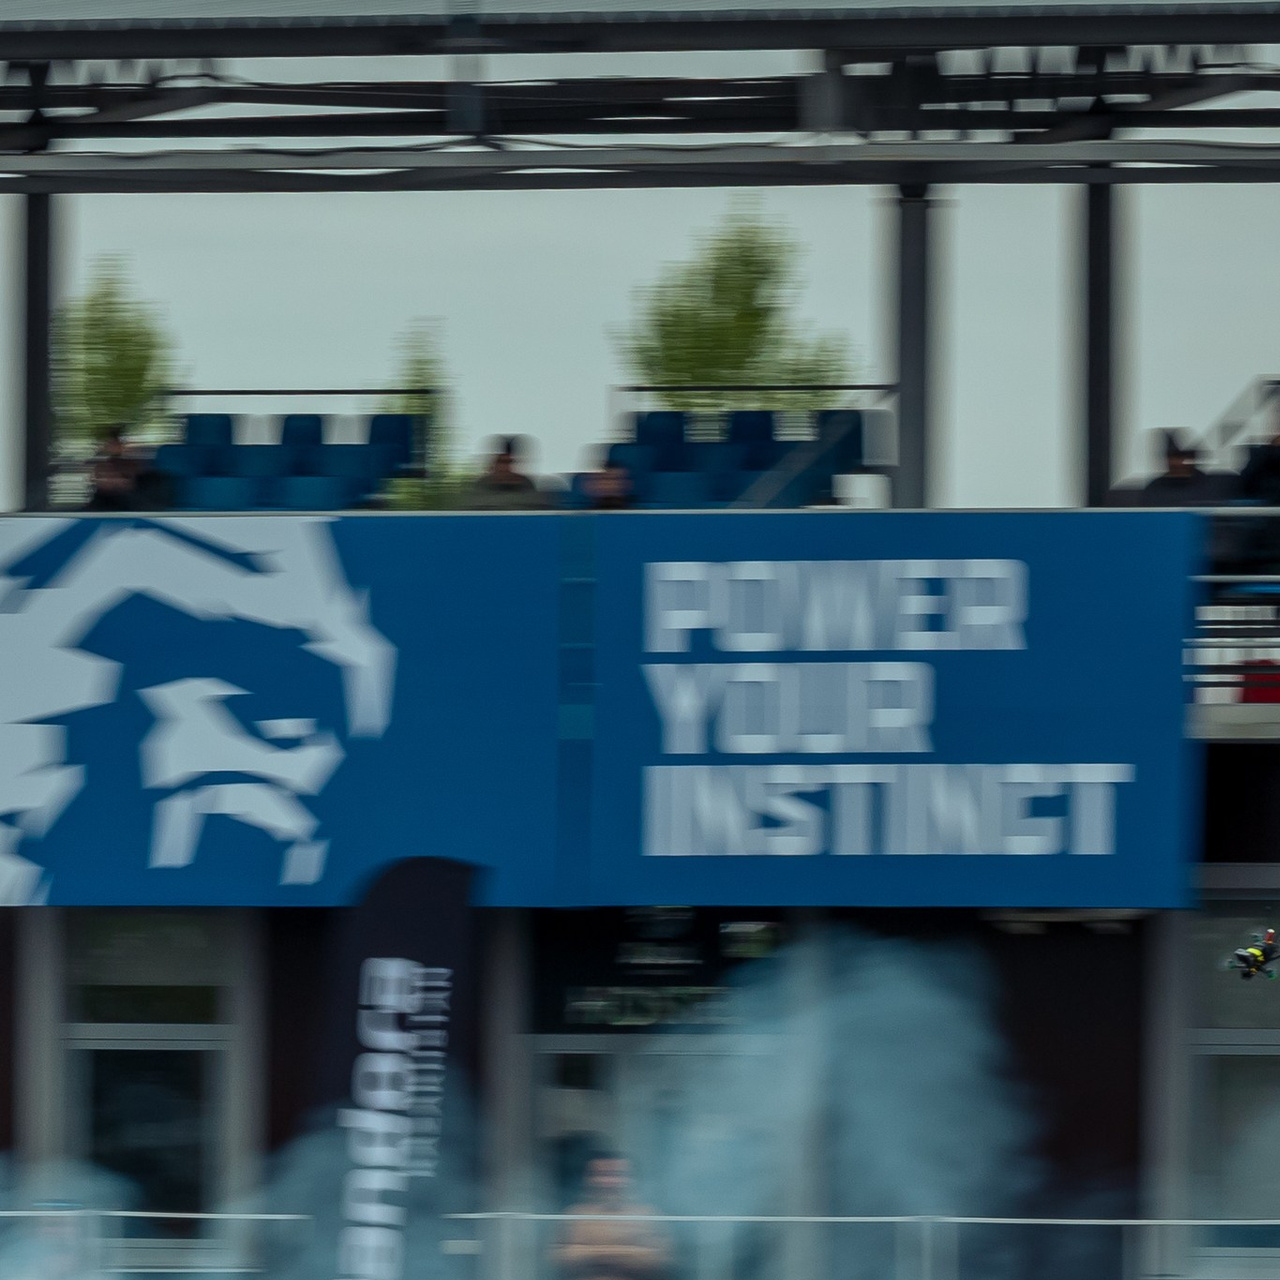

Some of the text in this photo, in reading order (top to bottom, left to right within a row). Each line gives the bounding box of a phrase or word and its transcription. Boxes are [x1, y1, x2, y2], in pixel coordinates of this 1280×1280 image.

[643, 560, 1029, 652] POWER
[641, 663, 936, 753] YOUR
[641, 764, 1134, 855] INSTINCT
